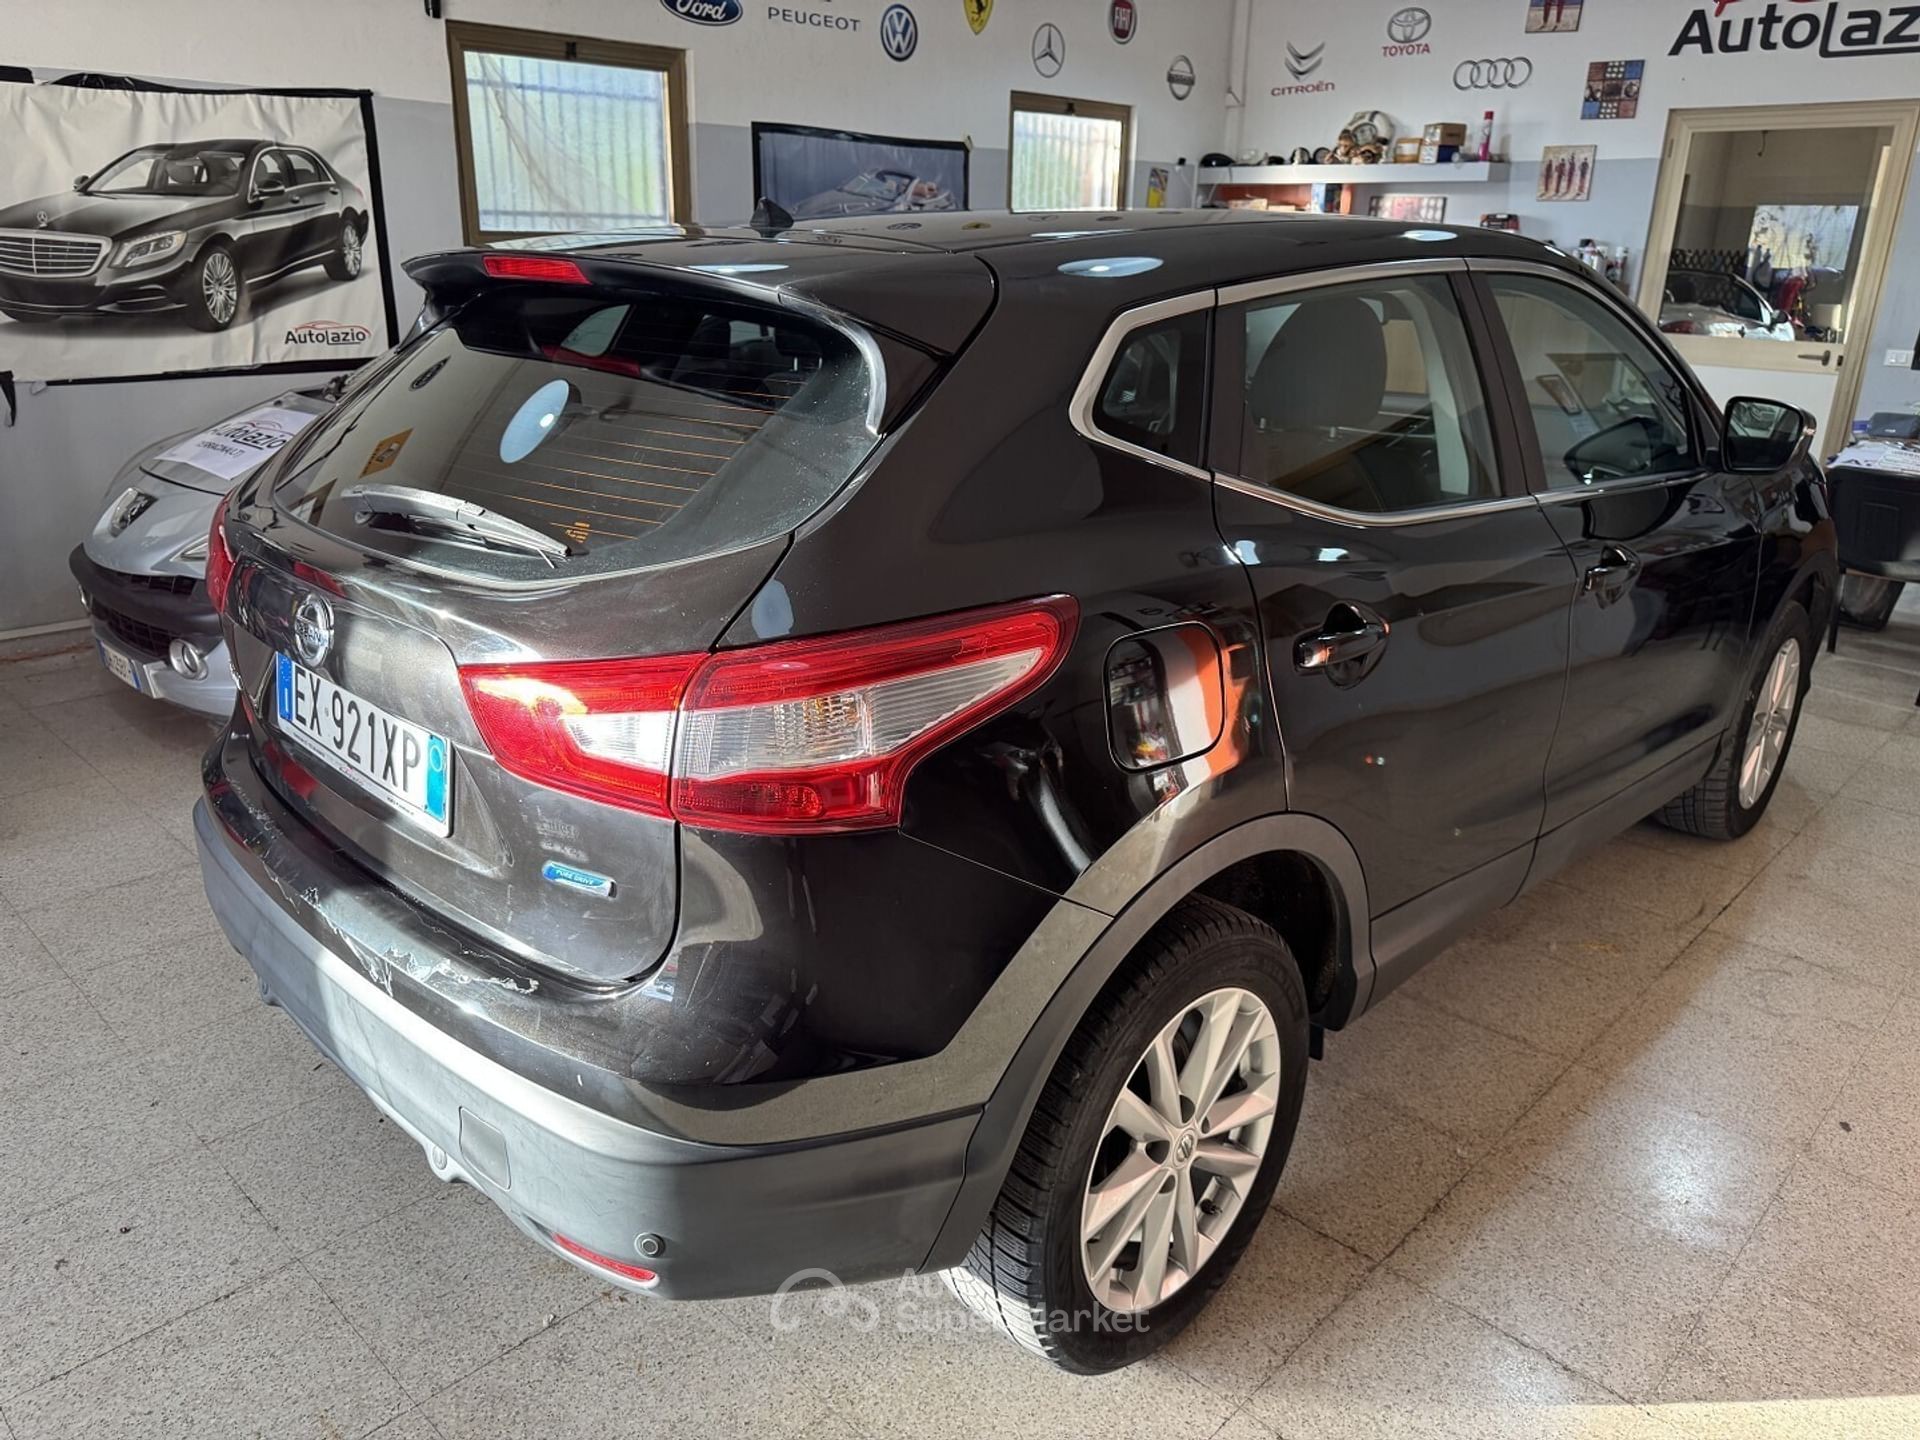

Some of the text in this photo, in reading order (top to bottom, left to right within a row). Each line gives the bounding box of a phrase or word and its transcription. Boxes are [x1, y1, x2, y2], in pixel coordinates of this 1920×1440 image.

[768, 6, 862, 32] PEUGEOT
[1381, 43, 1431, 57] TOYOTA
[331, 690, 421, 793] 921XP
